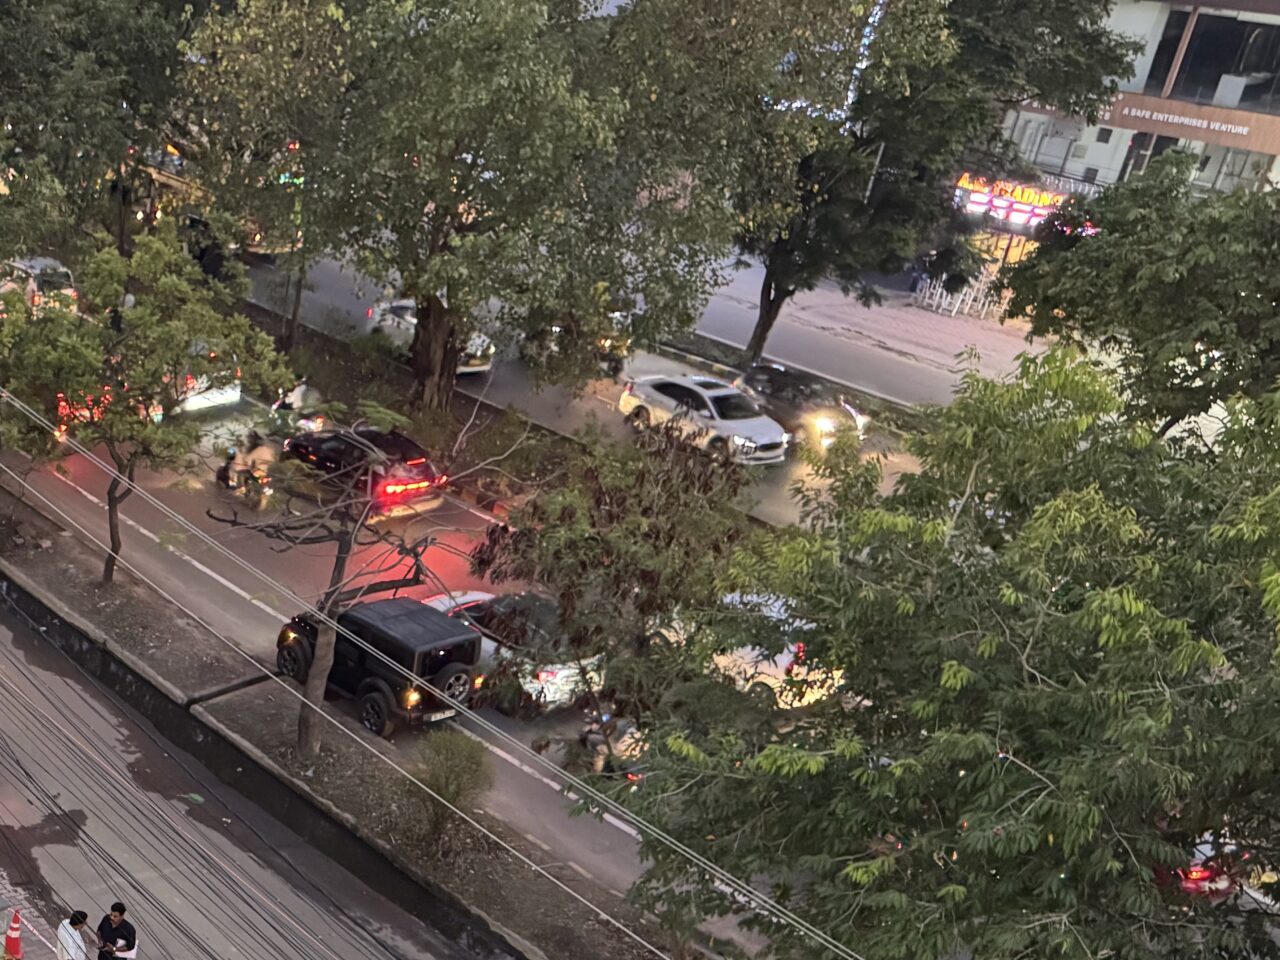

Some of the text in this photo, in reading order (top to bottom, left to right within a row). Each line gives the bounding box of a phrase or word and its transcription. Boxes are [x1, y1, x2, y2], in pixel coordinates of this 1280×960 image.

[1130, 107, 1151, 119] SAFE
[1152, 111, 1208, 128] ENTERPRISES
[1210, 121, 1250, 136] VENTURE
